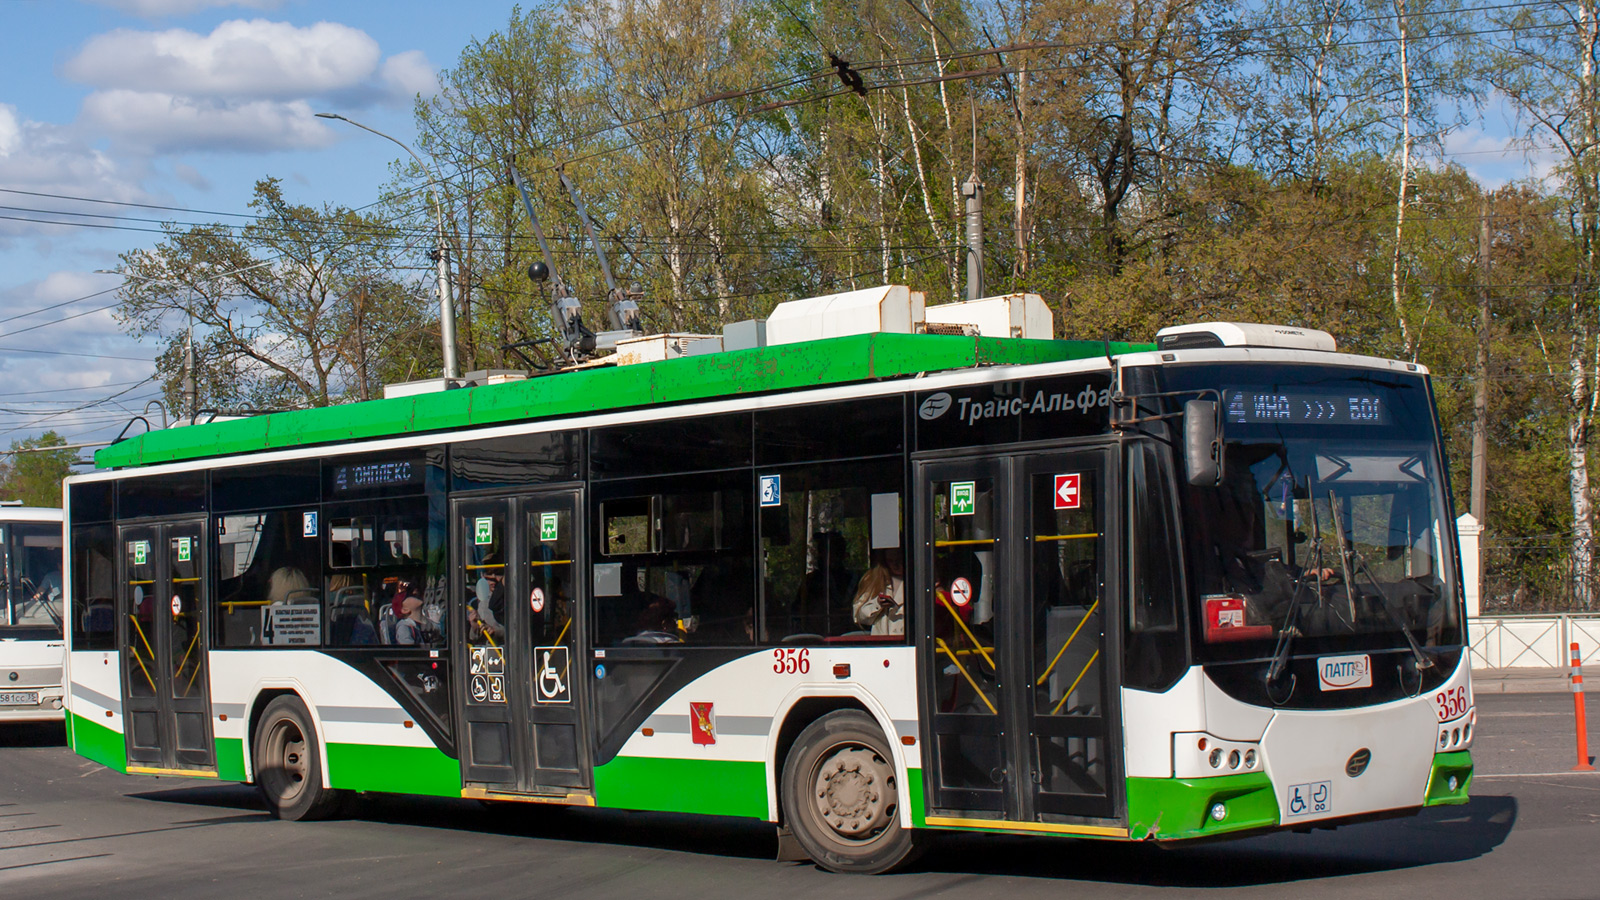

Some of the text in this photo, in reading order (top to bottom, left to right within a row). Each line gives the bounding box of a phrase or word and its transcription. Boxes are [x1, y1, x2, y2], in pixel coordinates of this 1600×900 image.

[957, 384, 1110, 426] Транс-Альфа
[1229, 391, 1246, 423] 4
[263, 608, 274, 645] 4
[773, 647, 810, 675] 356
[1436, 685, 1467, 720] 356
